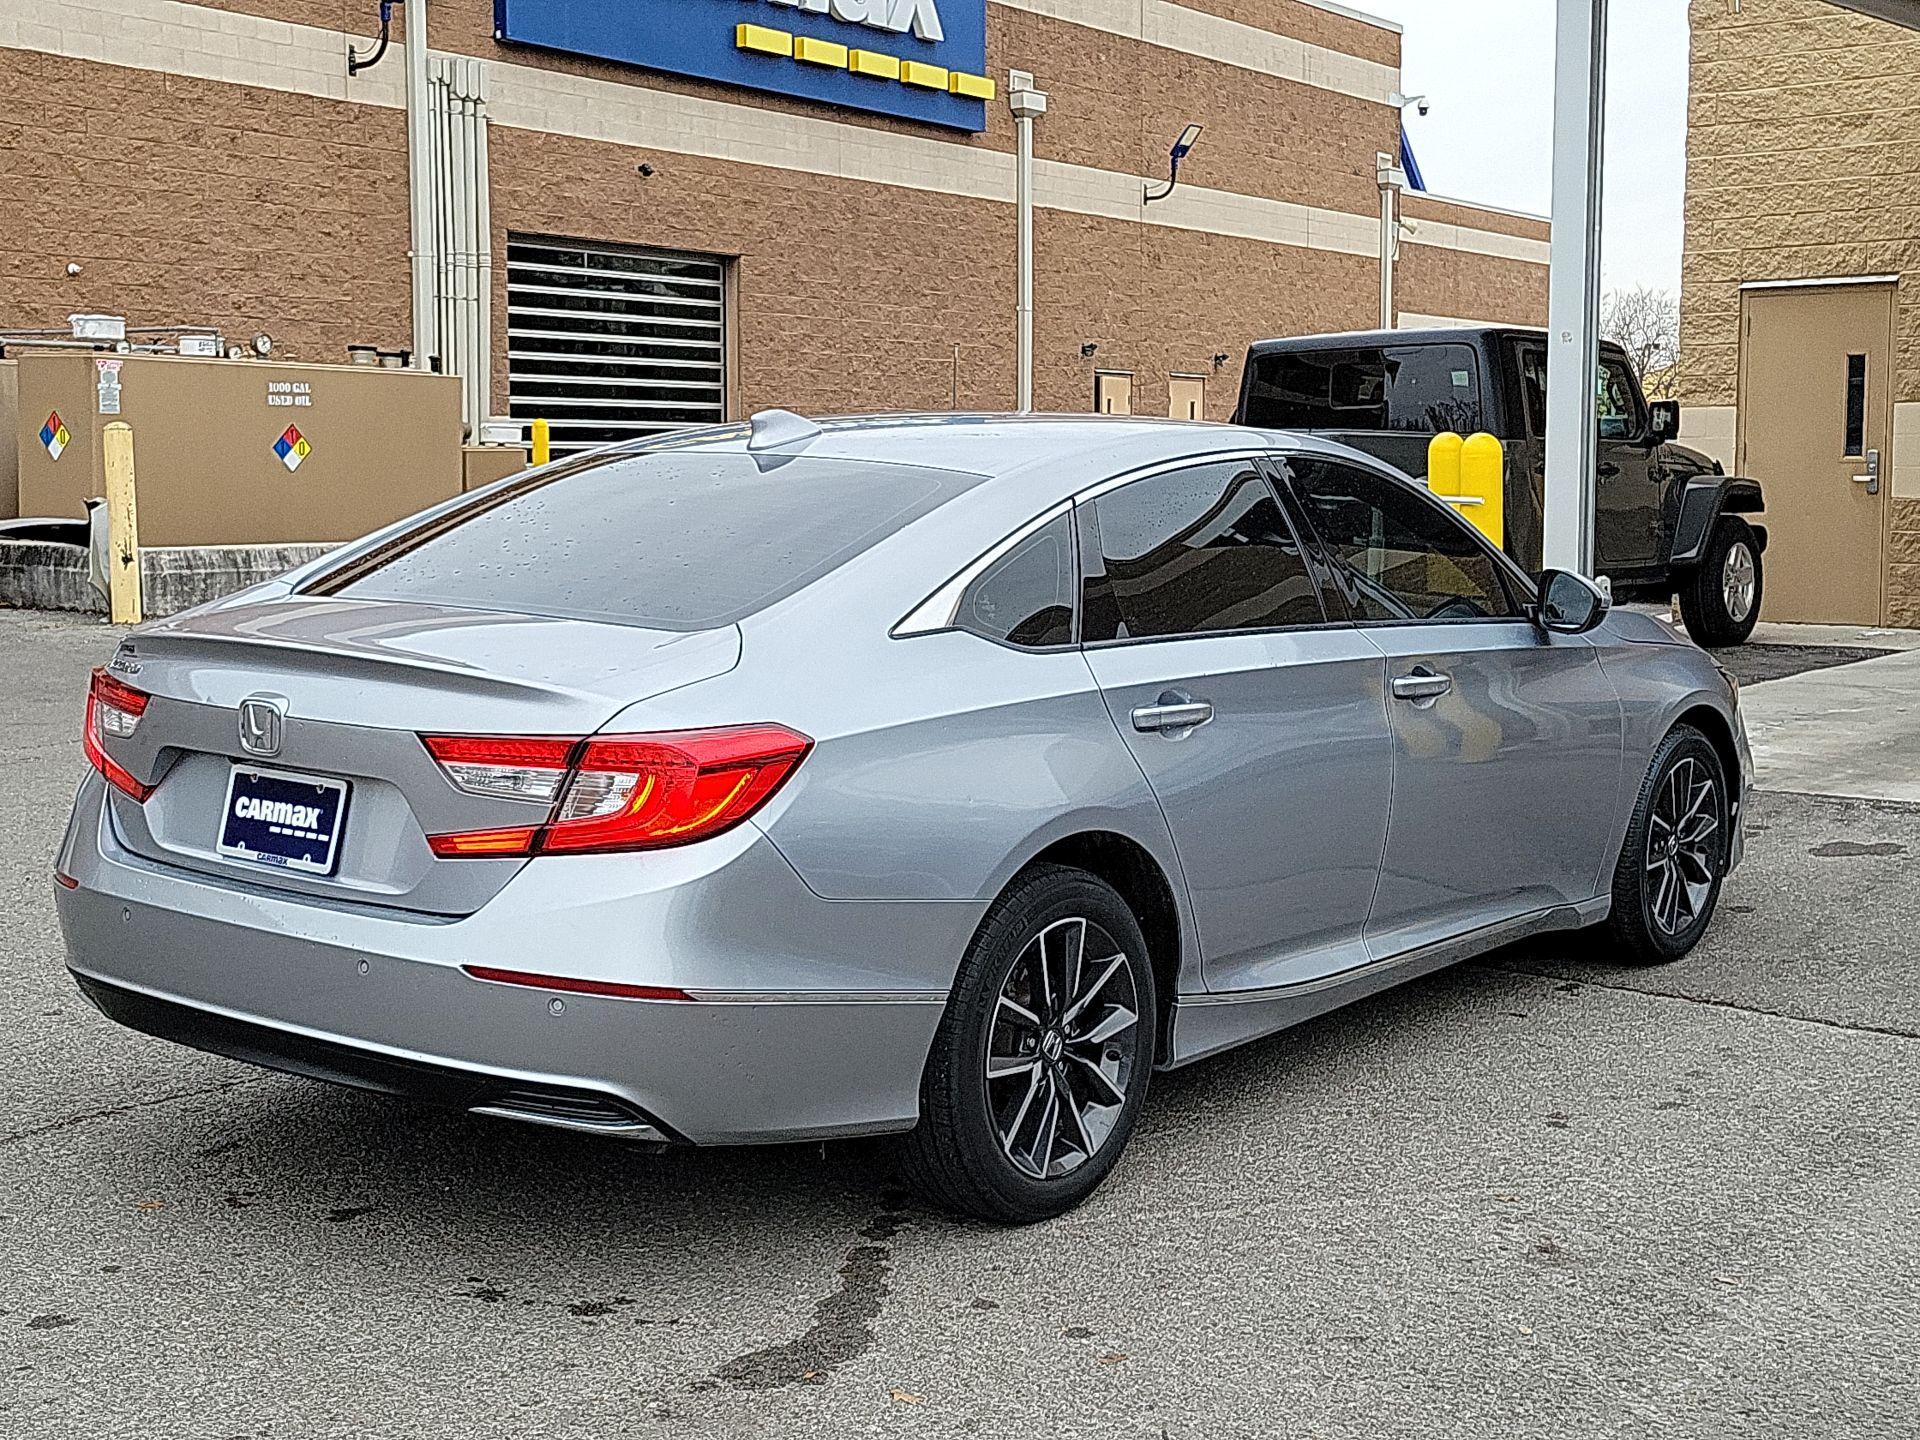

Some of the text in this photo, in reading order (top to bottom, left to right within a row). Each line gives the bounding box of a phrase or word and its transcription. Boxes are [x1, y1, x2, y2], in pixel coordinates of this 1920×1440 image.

[268, 382, 312, 394] 1000 GAL
[267, 394, 312, 407] USED OIL
[60, 428, 66, 445] 0
[299, 441, 306, 456] 0
